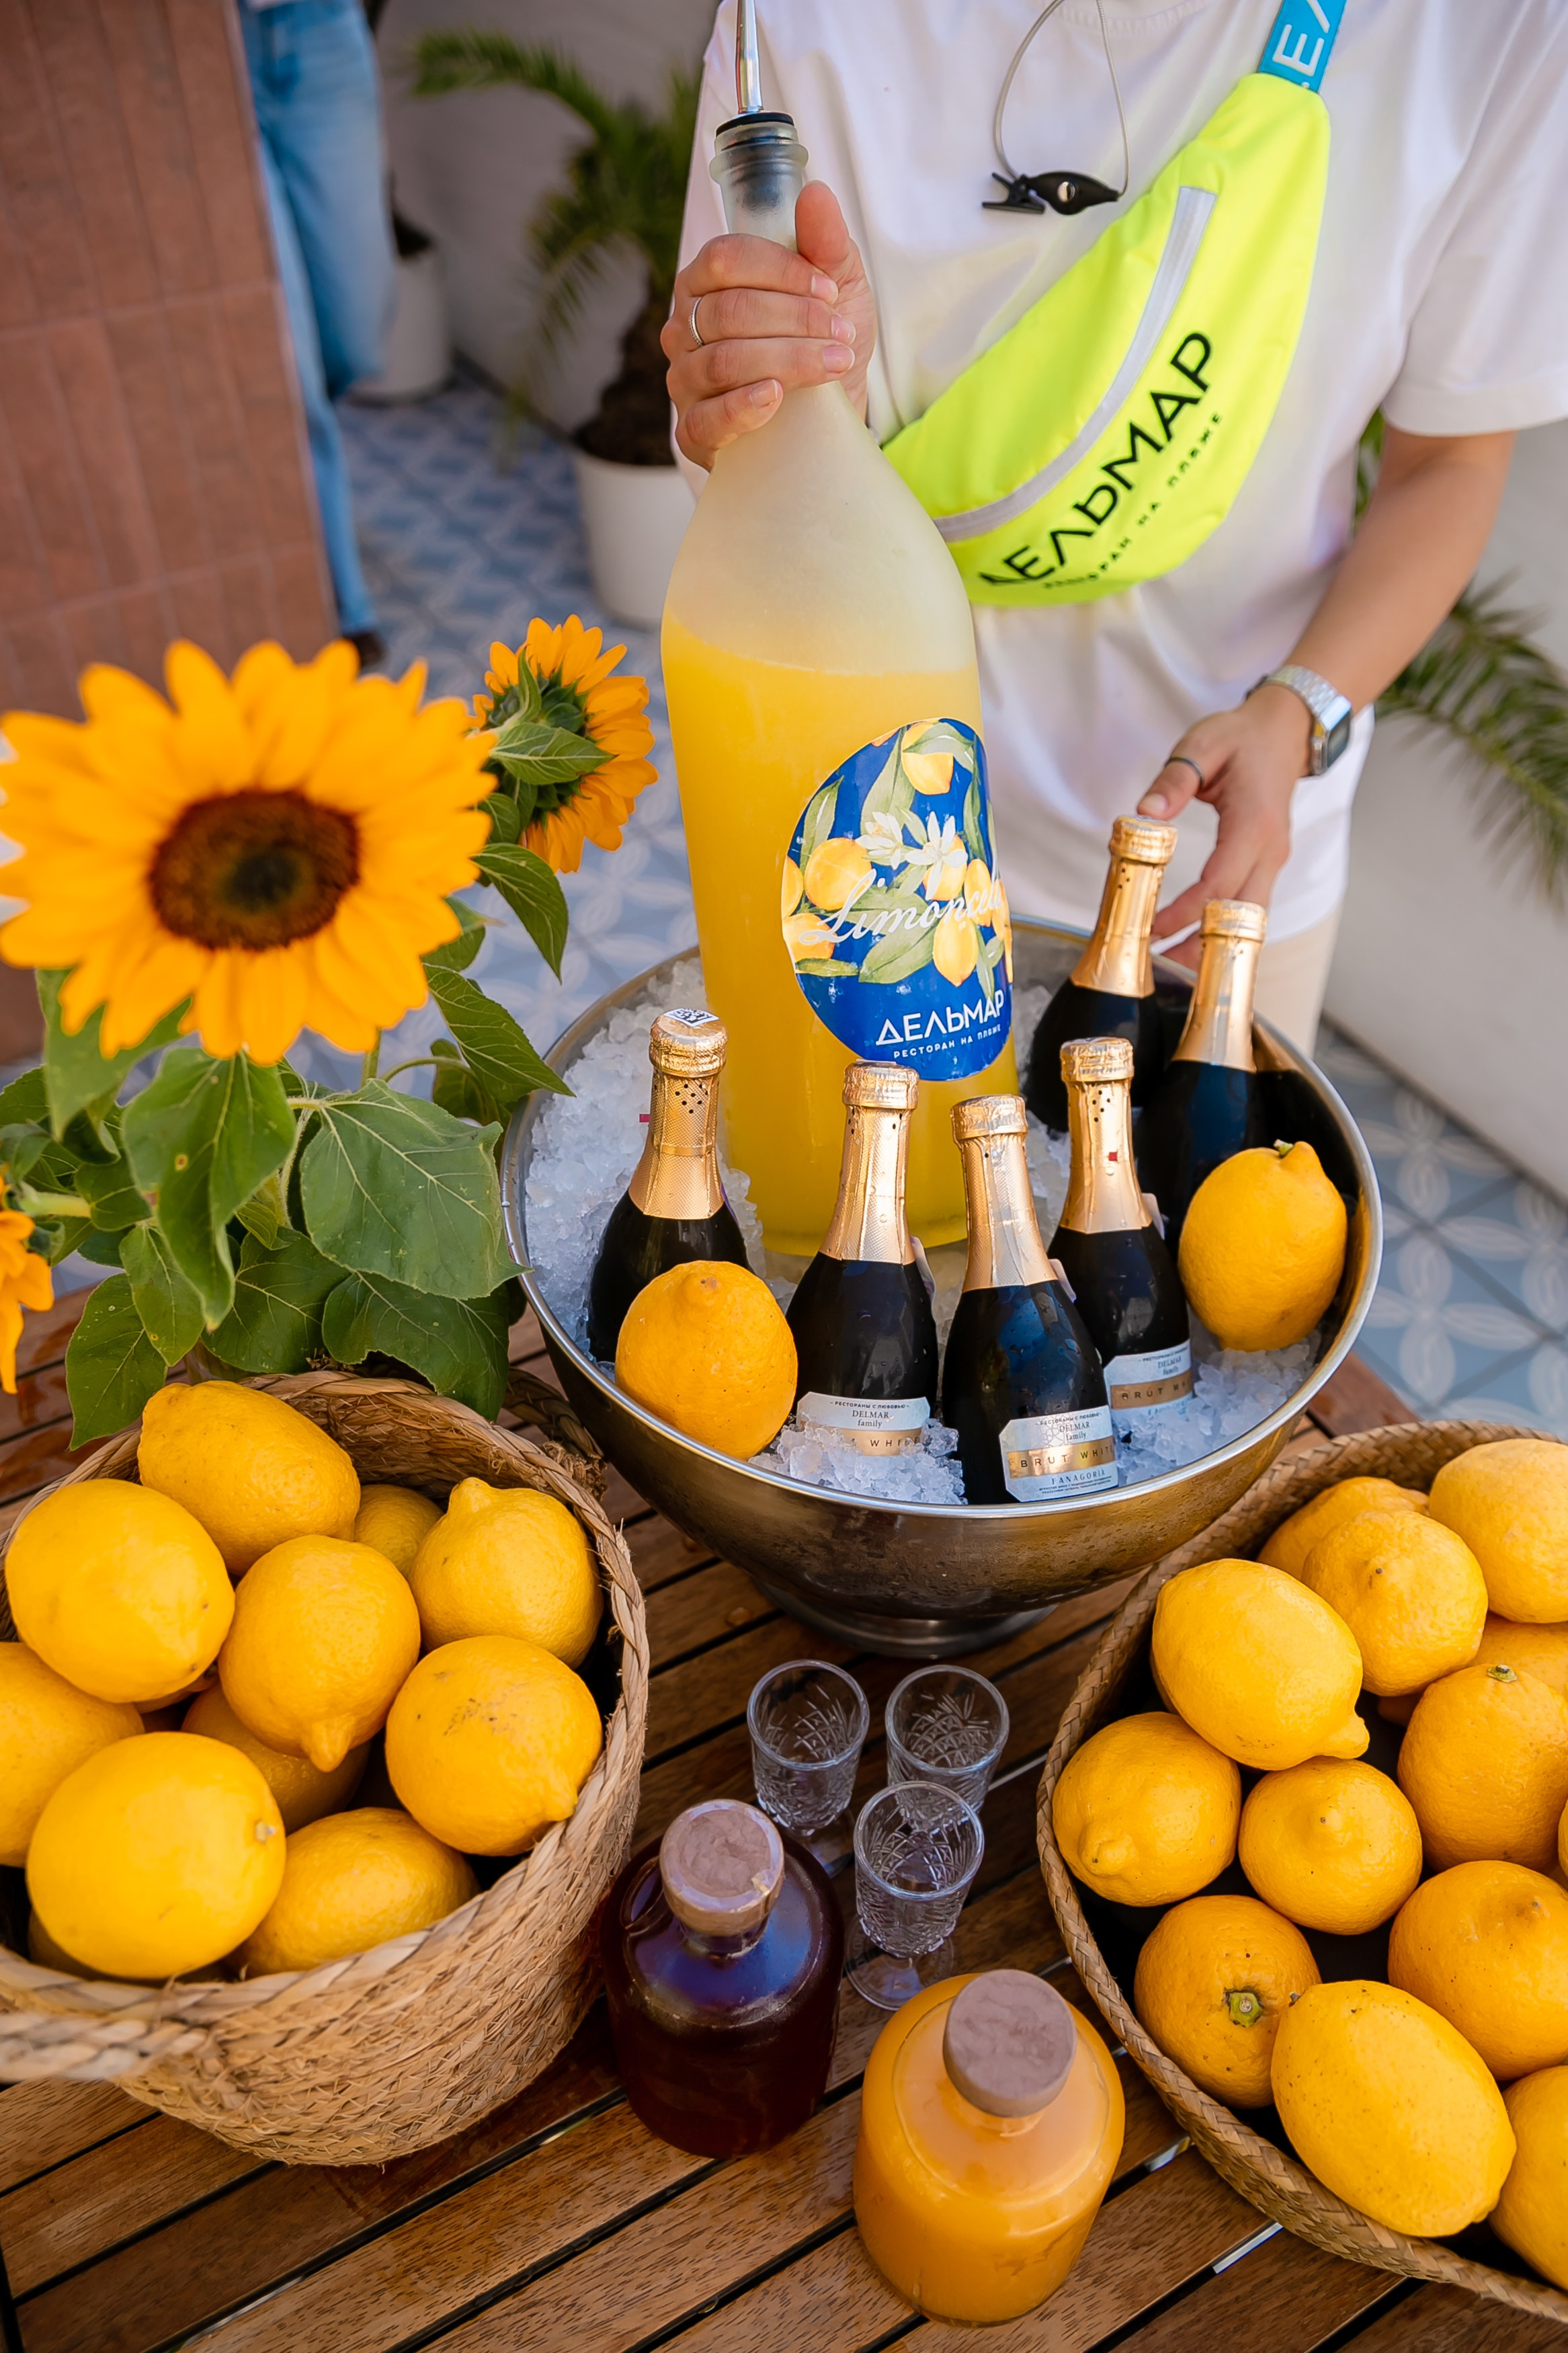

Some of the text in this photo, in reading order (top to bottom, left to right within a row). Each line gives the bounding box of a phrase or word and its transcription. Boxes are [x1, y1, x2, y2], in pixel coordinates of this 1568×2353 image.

[875, 989, 1005, 1046] ДЕЛЬМАР
[893, 1040, 955, 1059] РЕСТОРАН
[960, 1035, 973, 1045] НА
[1121, 1387, 1163, 1400] BRUT
[834, 1401, 870, 1409] РЕСТОРАНЫ
[852, 1410, 890, 1419] DELMAR
[857, 1419, 883, 1429] family
[1040, 1417, 1074, 1426] РЕСТОРАНЫ
[1059, 1421, 1090, 1433] DELMAR
[1066, 1431, 1087, 1441] family
[1020, 1454, 1068, 1468] BRUT
[1051, 1469, 1106, 1485] FANAGORIA
